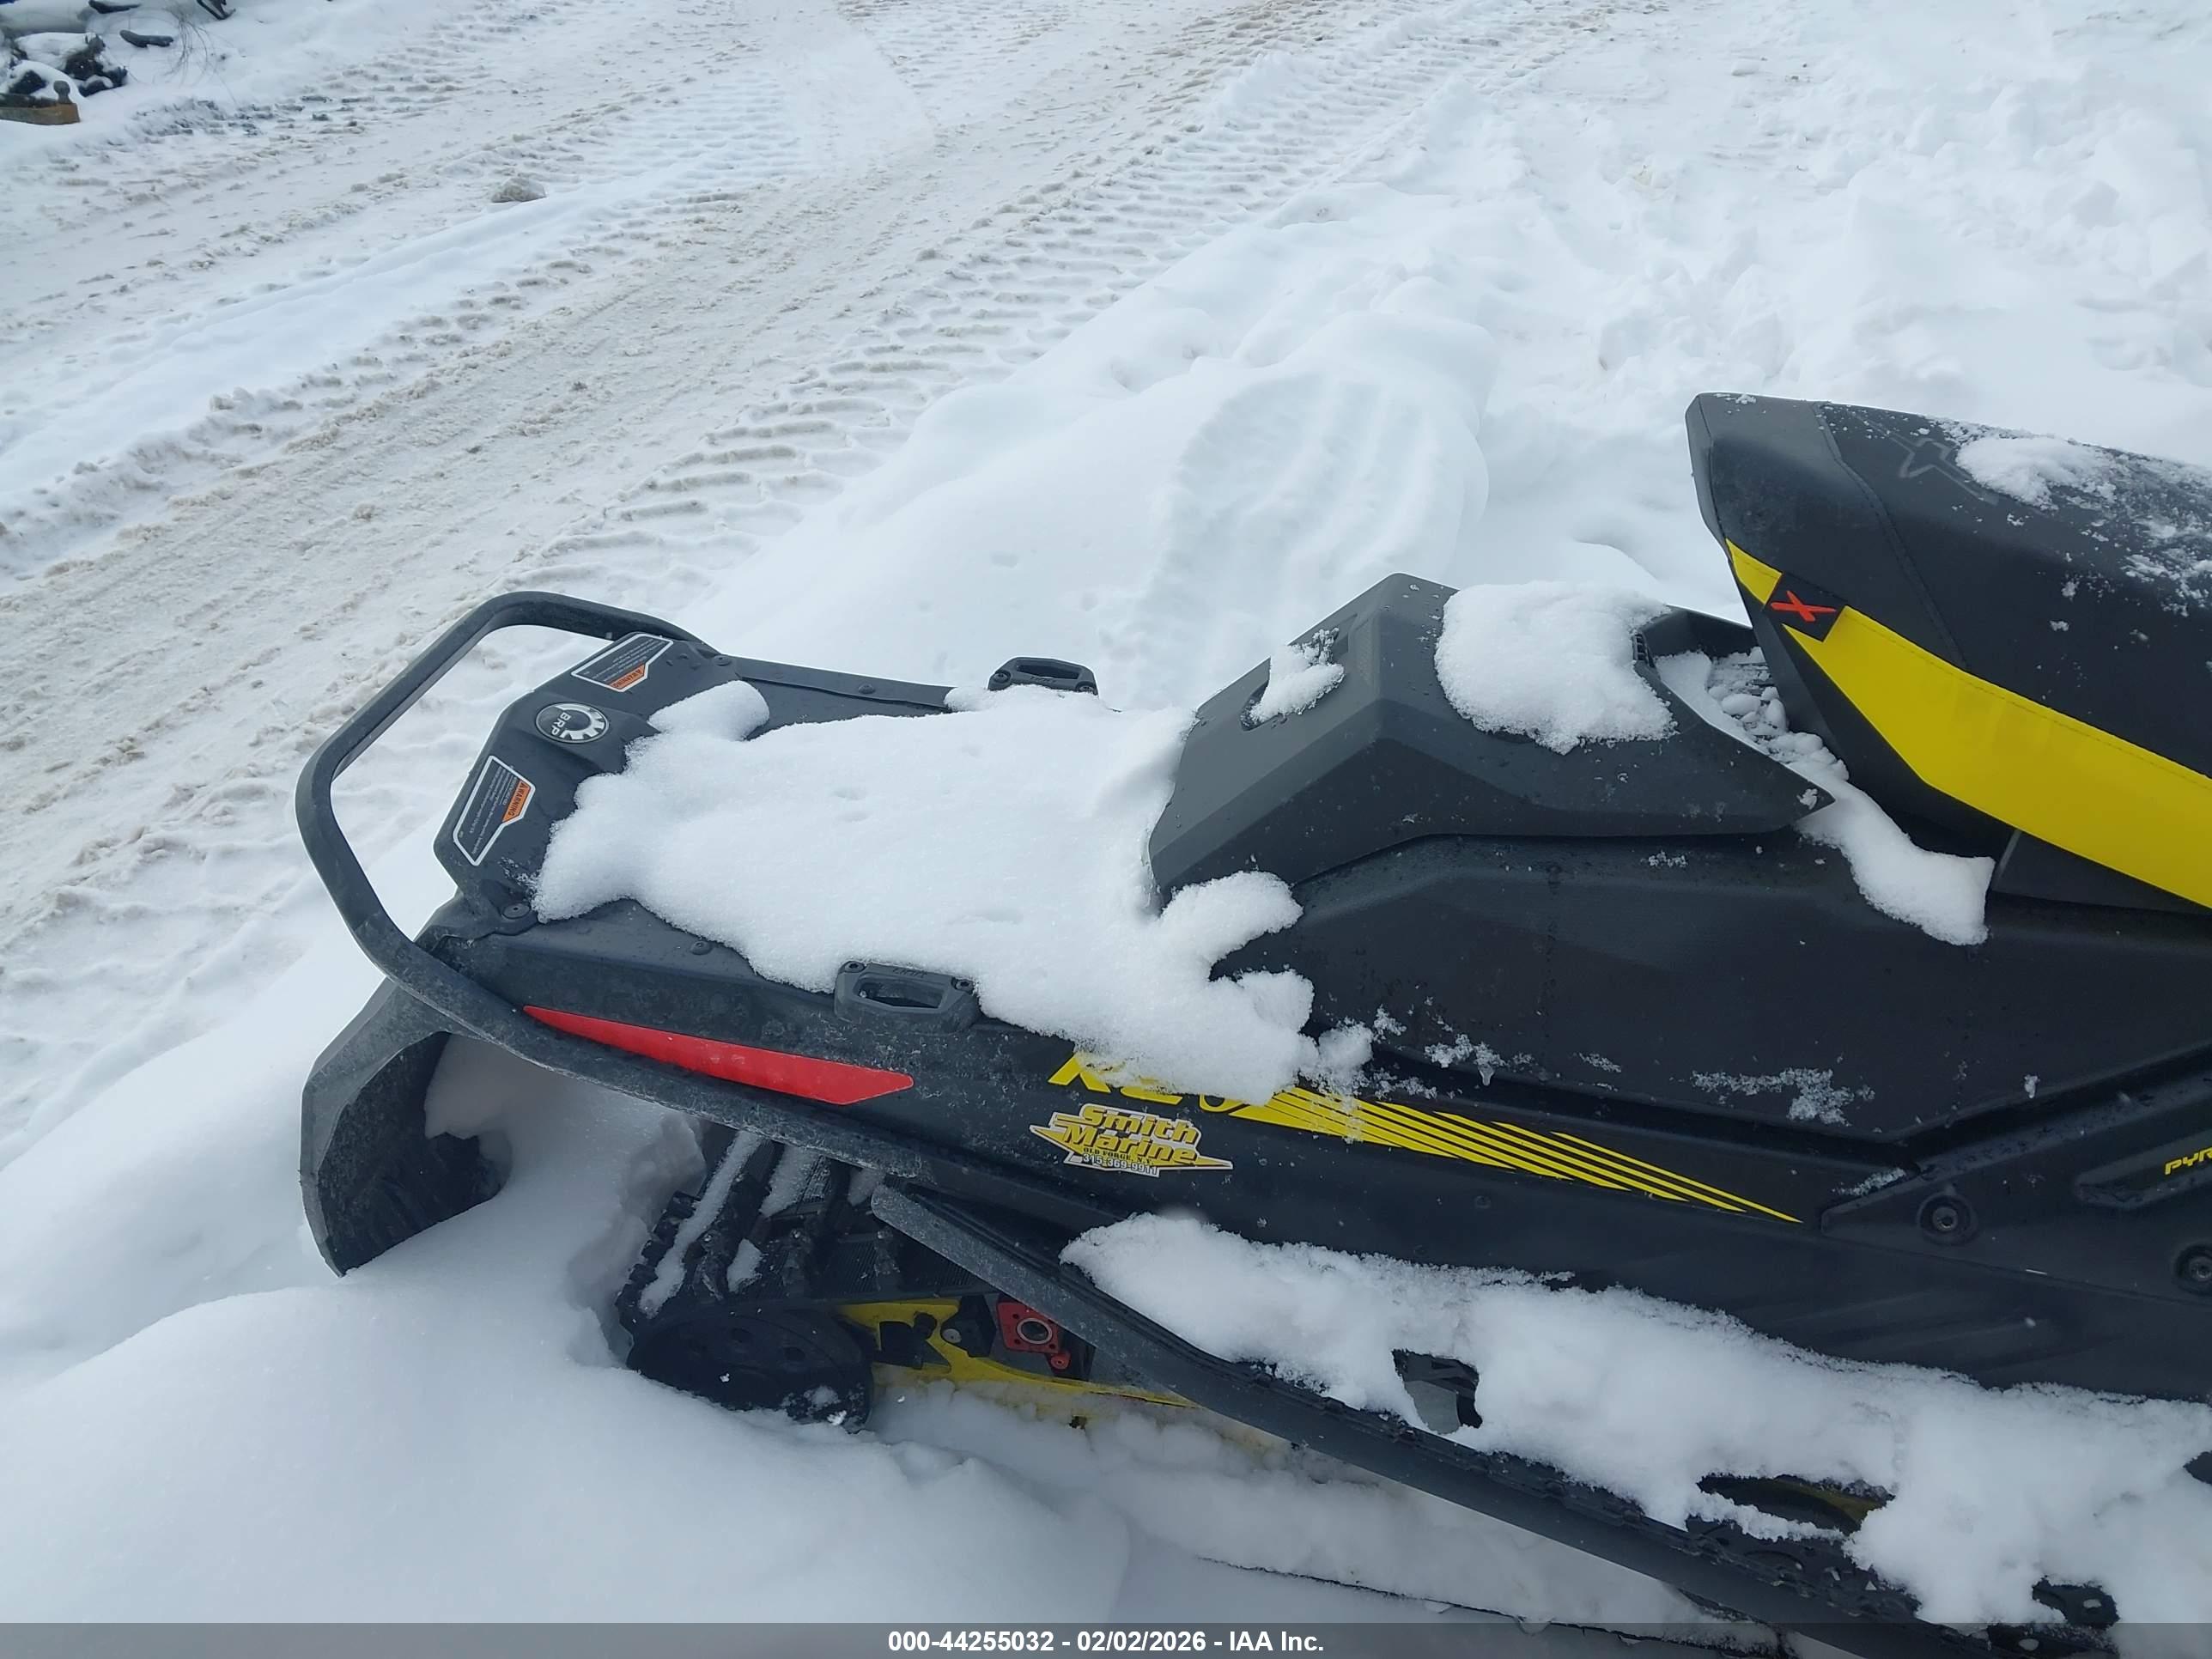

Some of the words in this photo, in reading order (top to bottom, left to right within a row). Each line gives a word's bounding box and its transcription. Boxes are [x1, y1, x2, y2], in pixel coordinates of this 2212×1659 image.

[551, 712, 572, 736] BRP
[507, 789, 525, 817] WARNING
[1061, 1104, 1199, 1146] Smith
[1057, 1123, 1200, 1165] Marine
[1083, 1153, 1158, 1176] 315-369-9911
